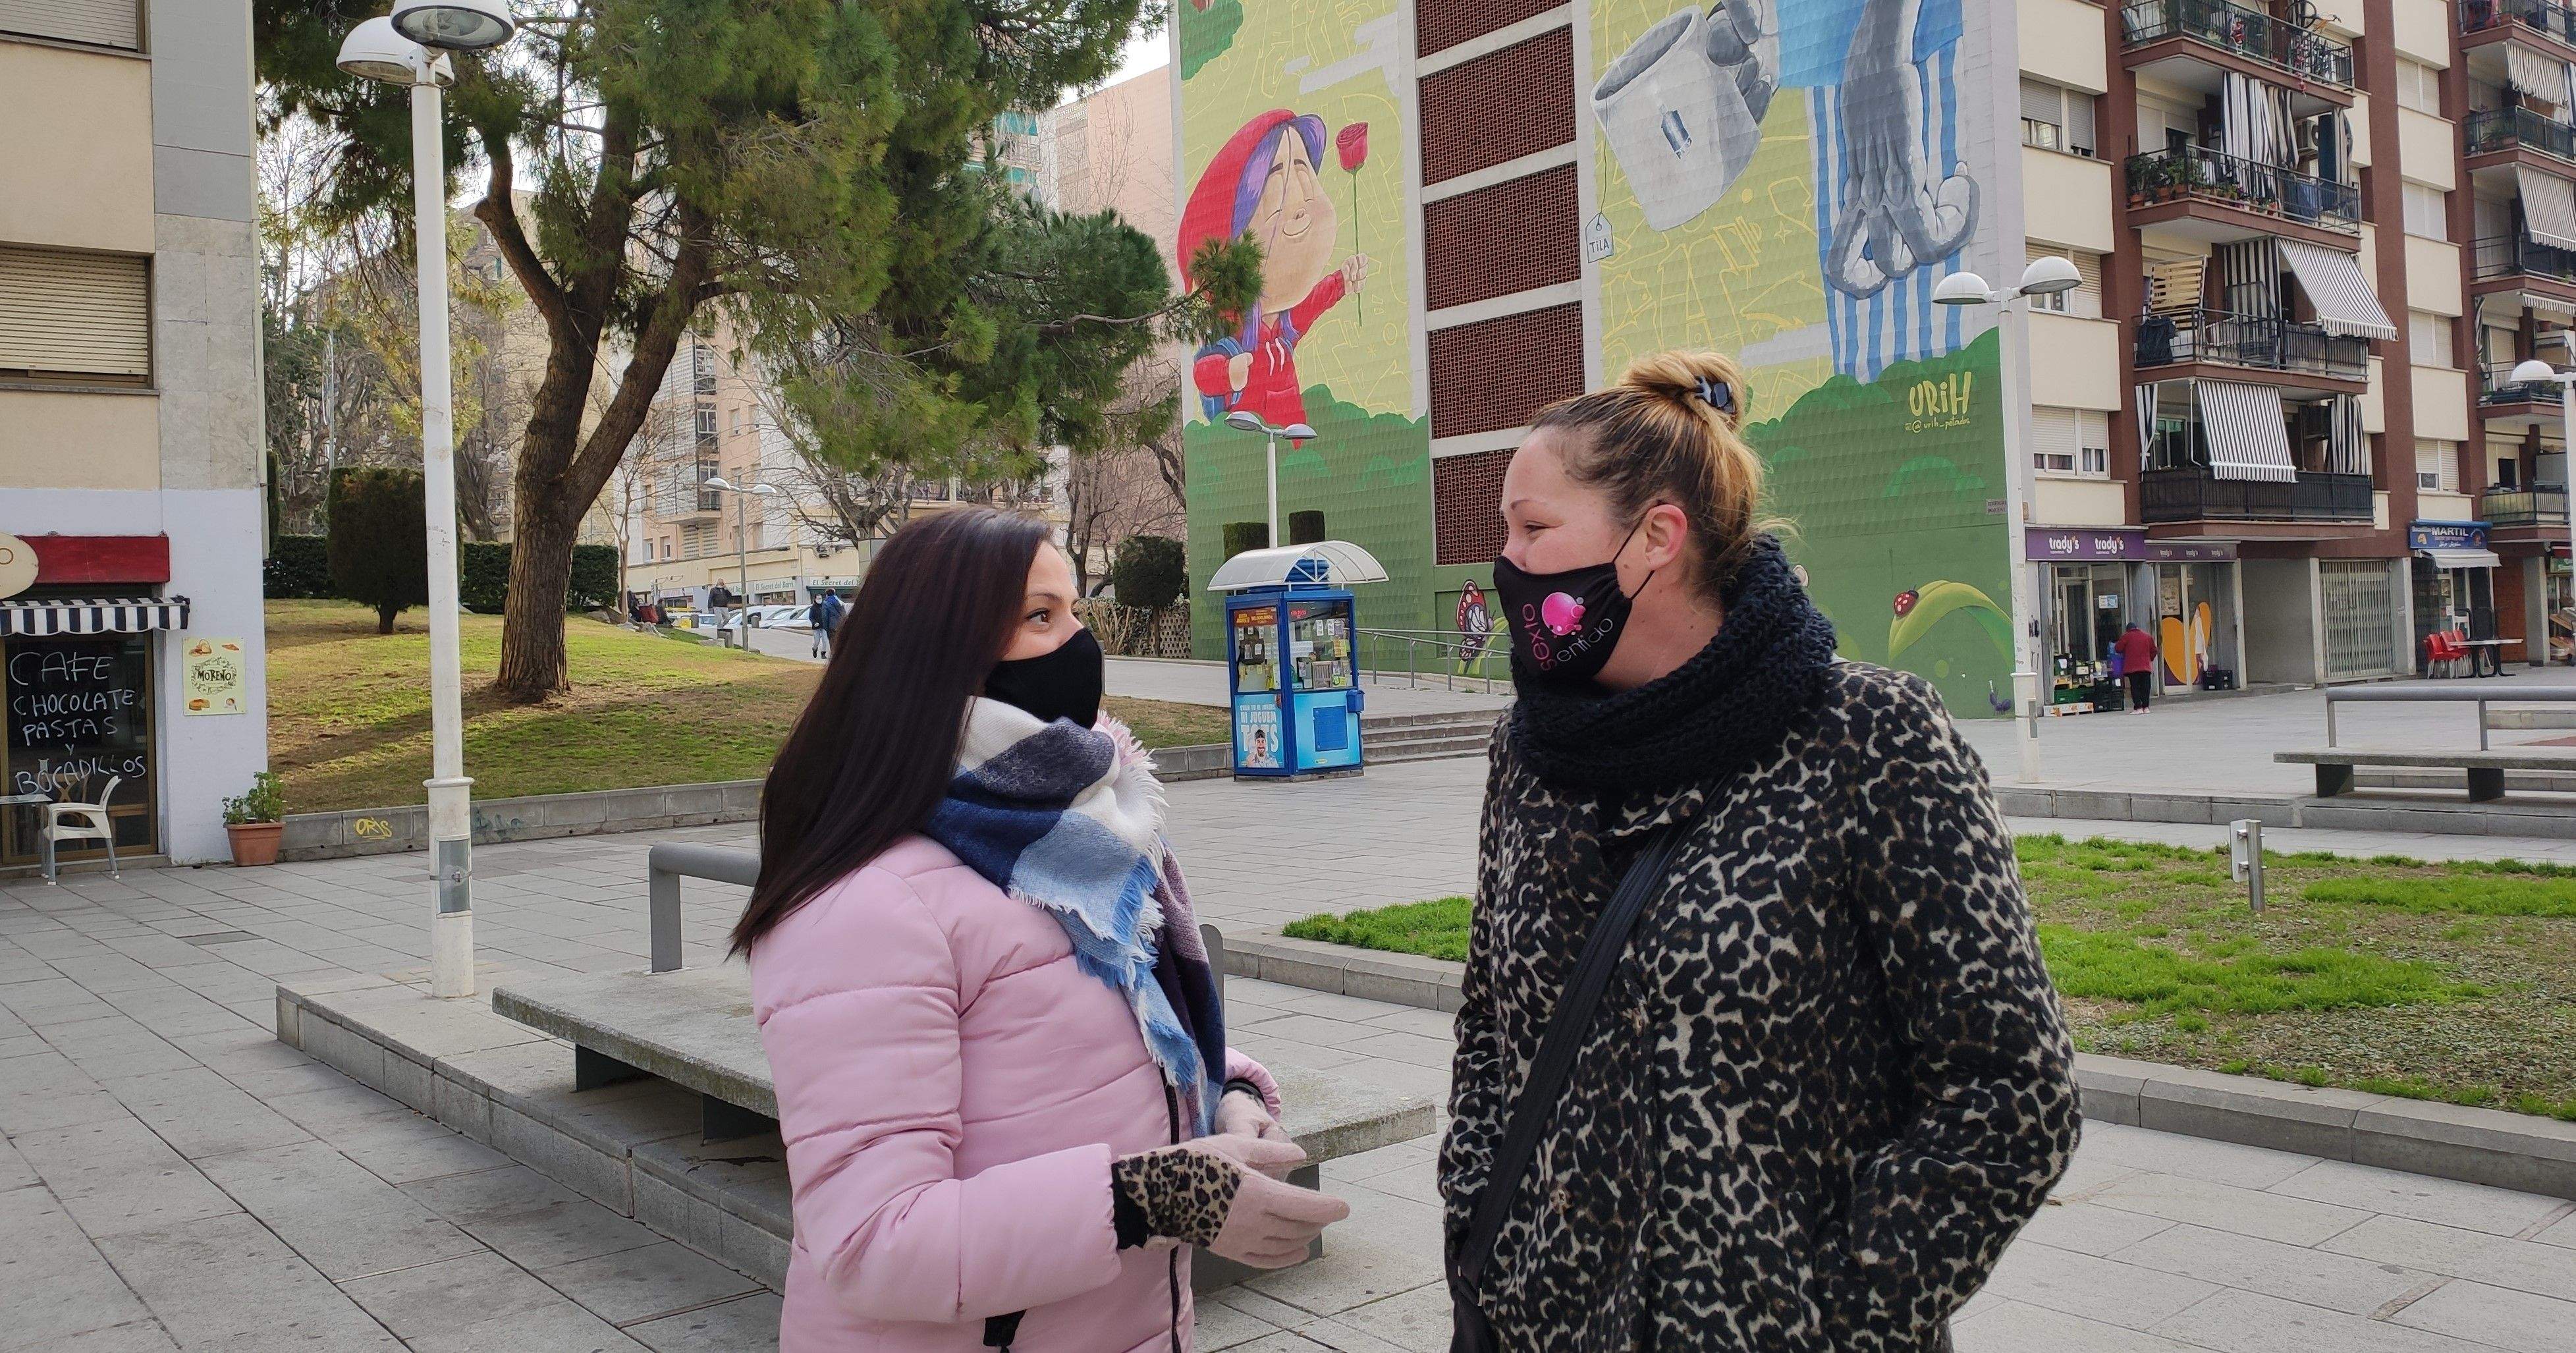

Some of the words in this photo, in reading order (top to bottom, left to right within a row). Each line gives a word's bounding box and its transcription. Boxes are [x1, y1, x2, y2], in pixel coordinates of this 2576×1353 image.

[2048, 535, 2079, 554] trady's
[2095, 536, 2124, 554] trady's
[2432, 527, 2469, 537] MARTIL
[10, 651, 114, 686] CAFE
[13, 688, 135, 717] CHOCOLATE
[22, 716, 118, 746] PASTAS
[15, 754, 146, 794] BOCADILLOS
